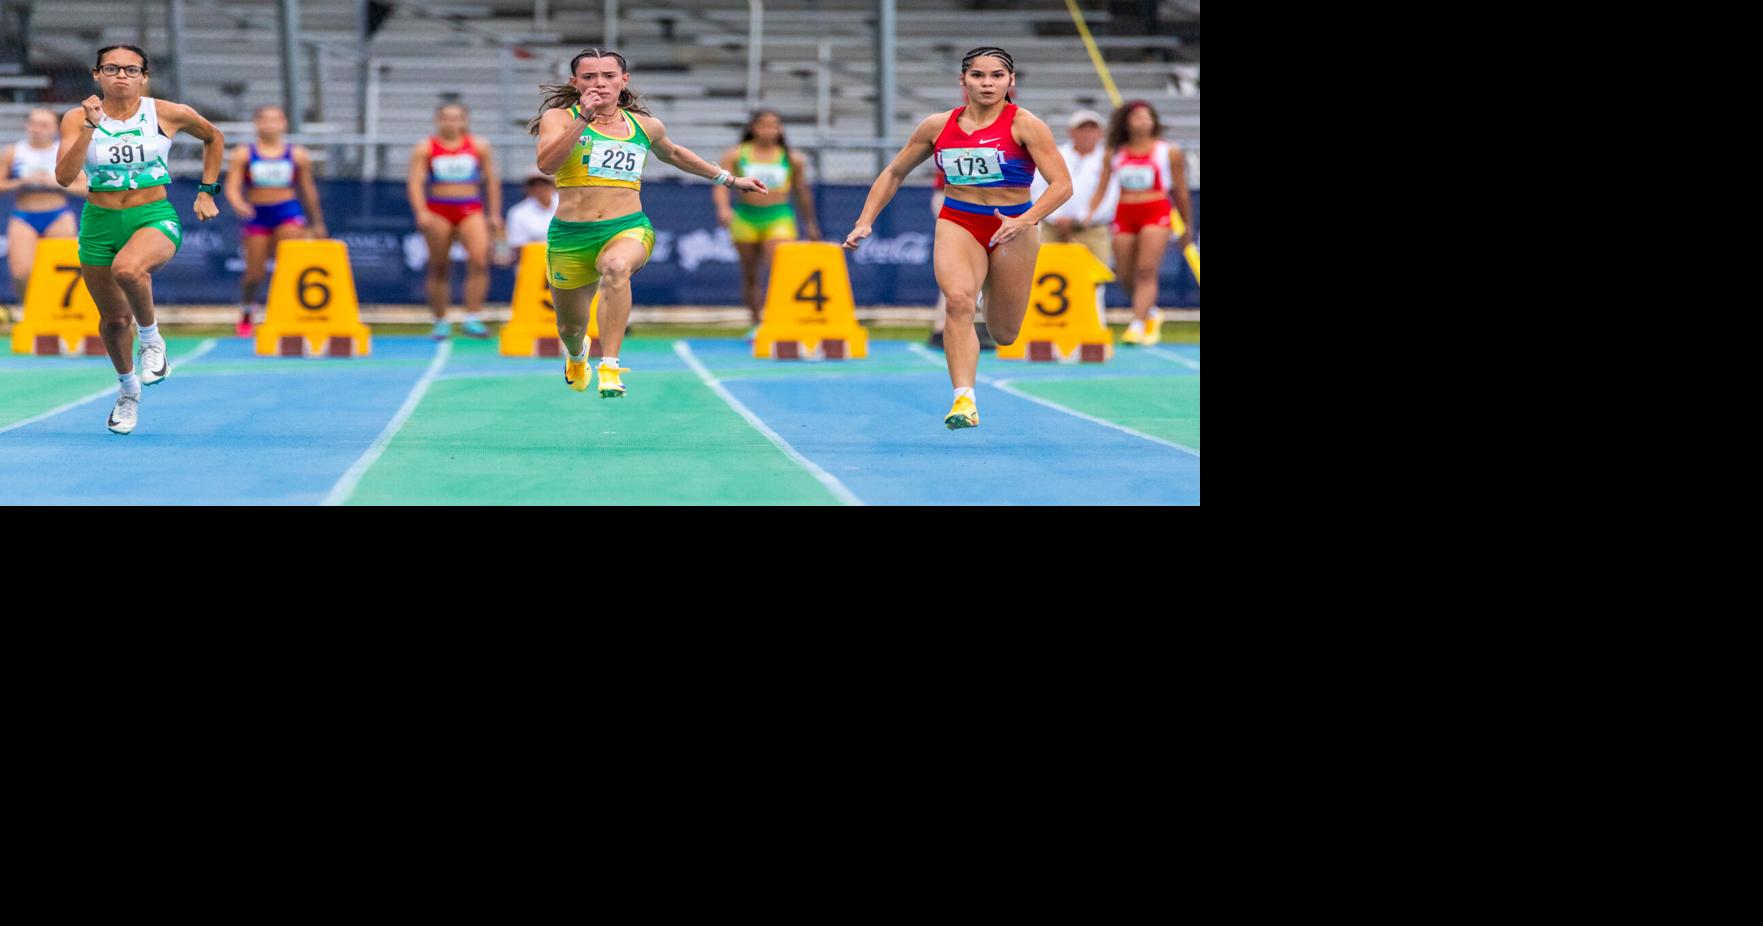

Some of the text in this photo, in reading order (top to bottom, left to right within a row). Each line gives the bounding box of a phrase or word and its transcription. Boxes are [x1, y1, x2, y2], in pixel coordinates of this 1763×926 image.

[108, 144, 145, 164] 391
[601, 149, 636, 172] 225
[953, 157, 989, 176] 173
[55, 264, 82, 308] 7
[296, 266, 331, 310] 6
[794, 269, 829, 312] 4
[1035, 273, 1070, 316] 3
